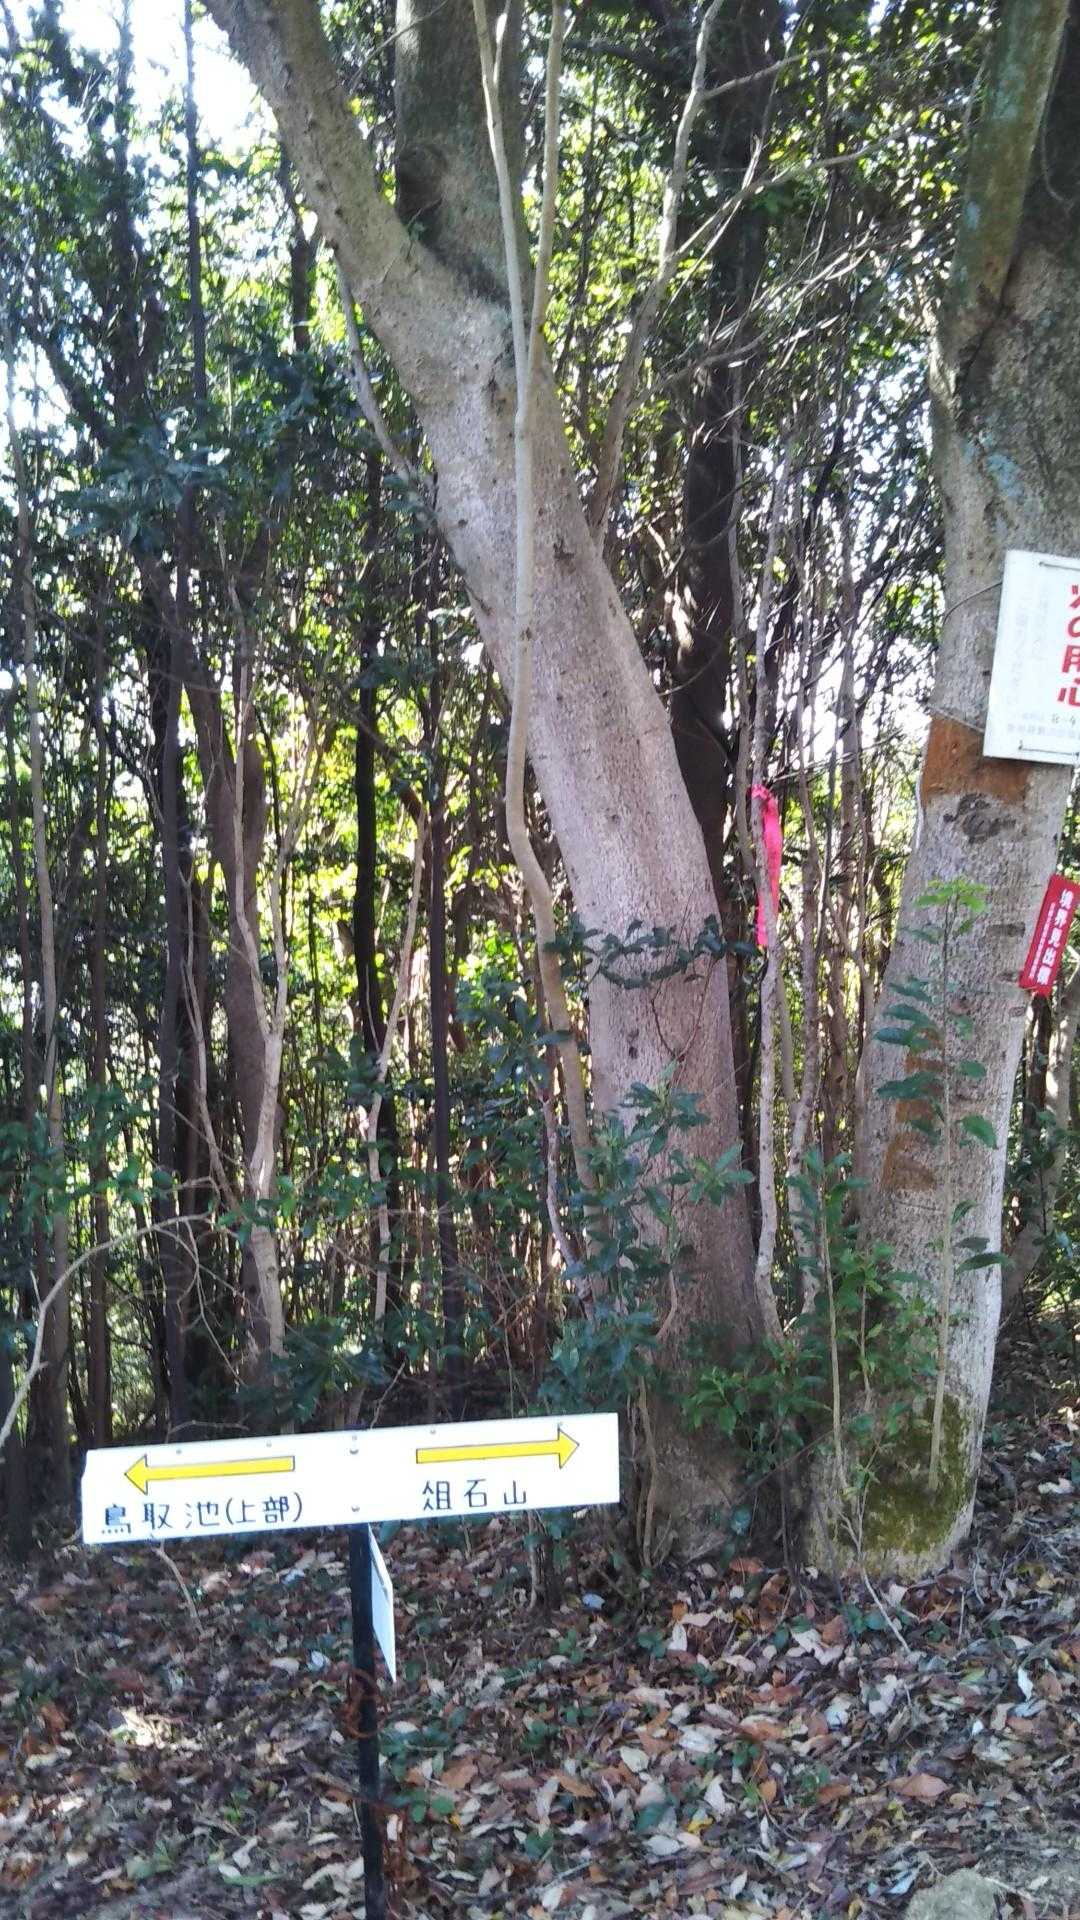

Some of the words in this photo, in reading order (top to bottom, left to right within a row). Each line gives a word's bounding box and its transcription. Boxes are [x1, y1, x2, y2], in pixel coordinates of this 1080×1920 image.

[101, 1491, 303, 1534] 鳥取池(上部)
[422, 1478, 527, 1510] 俎石山
